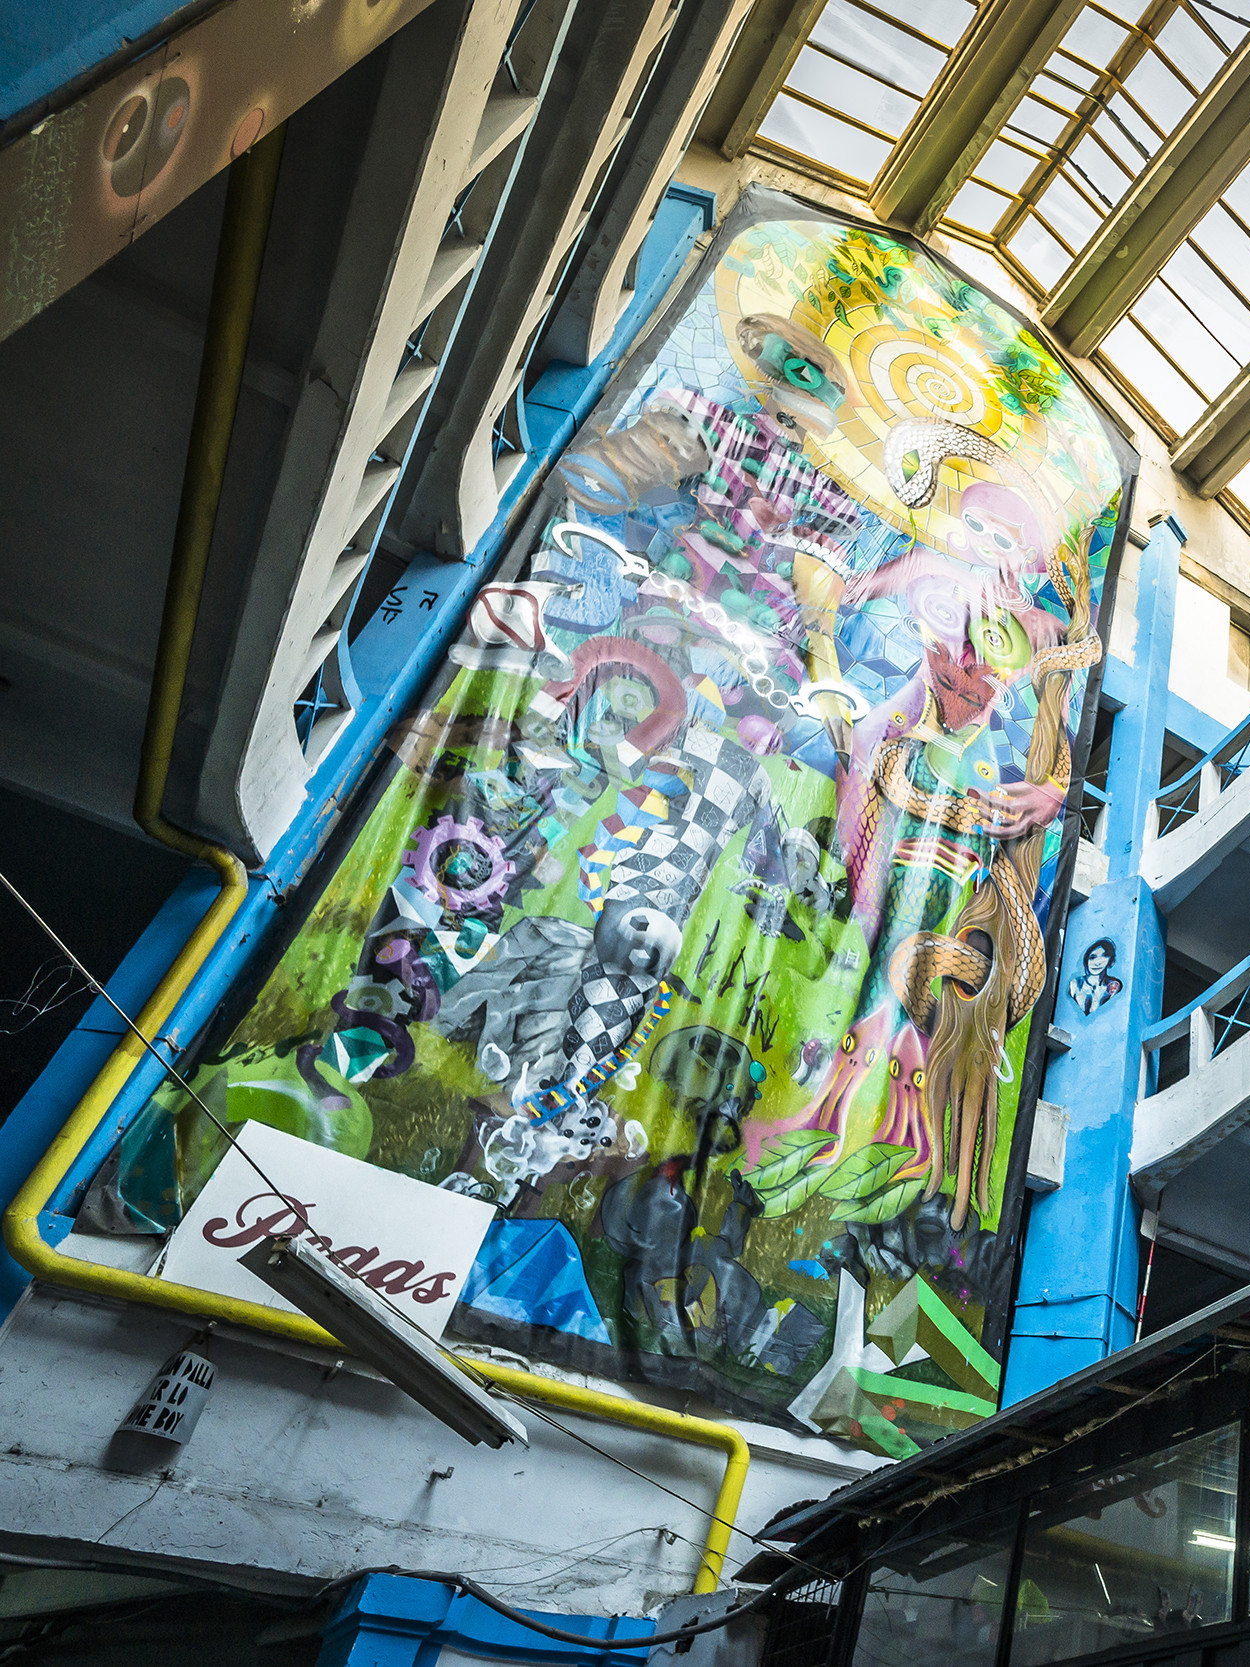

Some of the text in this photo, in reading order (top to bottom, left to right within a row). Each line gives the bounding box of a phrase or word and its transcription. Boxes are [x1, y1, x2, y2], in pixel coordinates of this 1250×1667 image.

[181, 1358, 215, 1390] DALLA
[167, 1382, 189, 1406] LO
[153, 1407, 185, 1434] BOY
